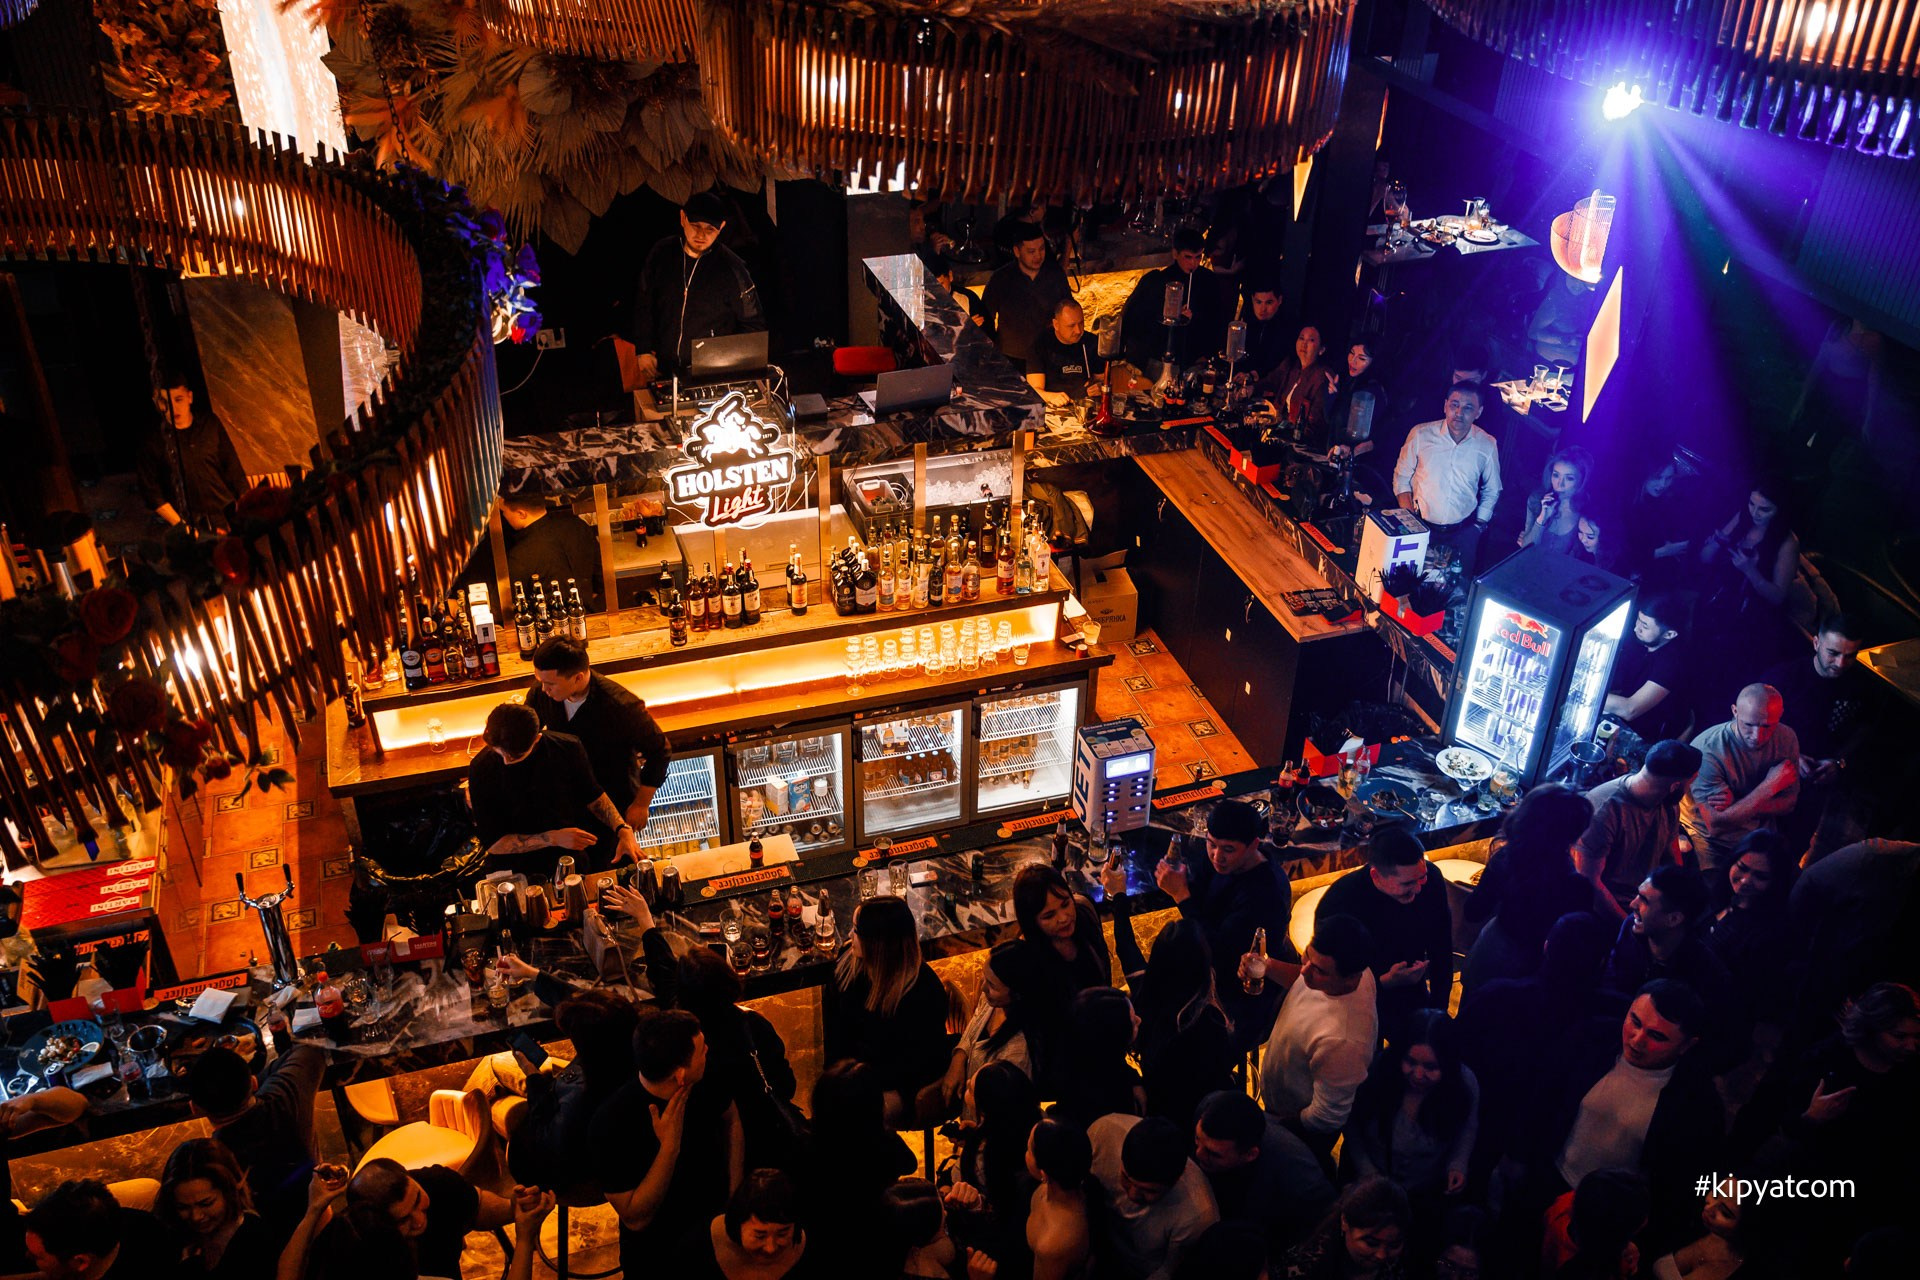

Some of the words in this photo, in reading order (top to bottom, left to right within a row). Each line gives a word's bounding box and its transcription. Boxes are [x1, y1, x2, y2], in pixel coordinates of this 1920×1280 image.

[677, 457, 788, 497] HOLSTEN
[710, 485, 765, 522] Light
[1521, 633, 1551, 658] Bull
[1074, 739, 1092, 824] JET
[109, 862, 153, 874] MARTINI
[102, 881, 147, 893] MARTINI
[92, 898, 138, 911] MARTINI
